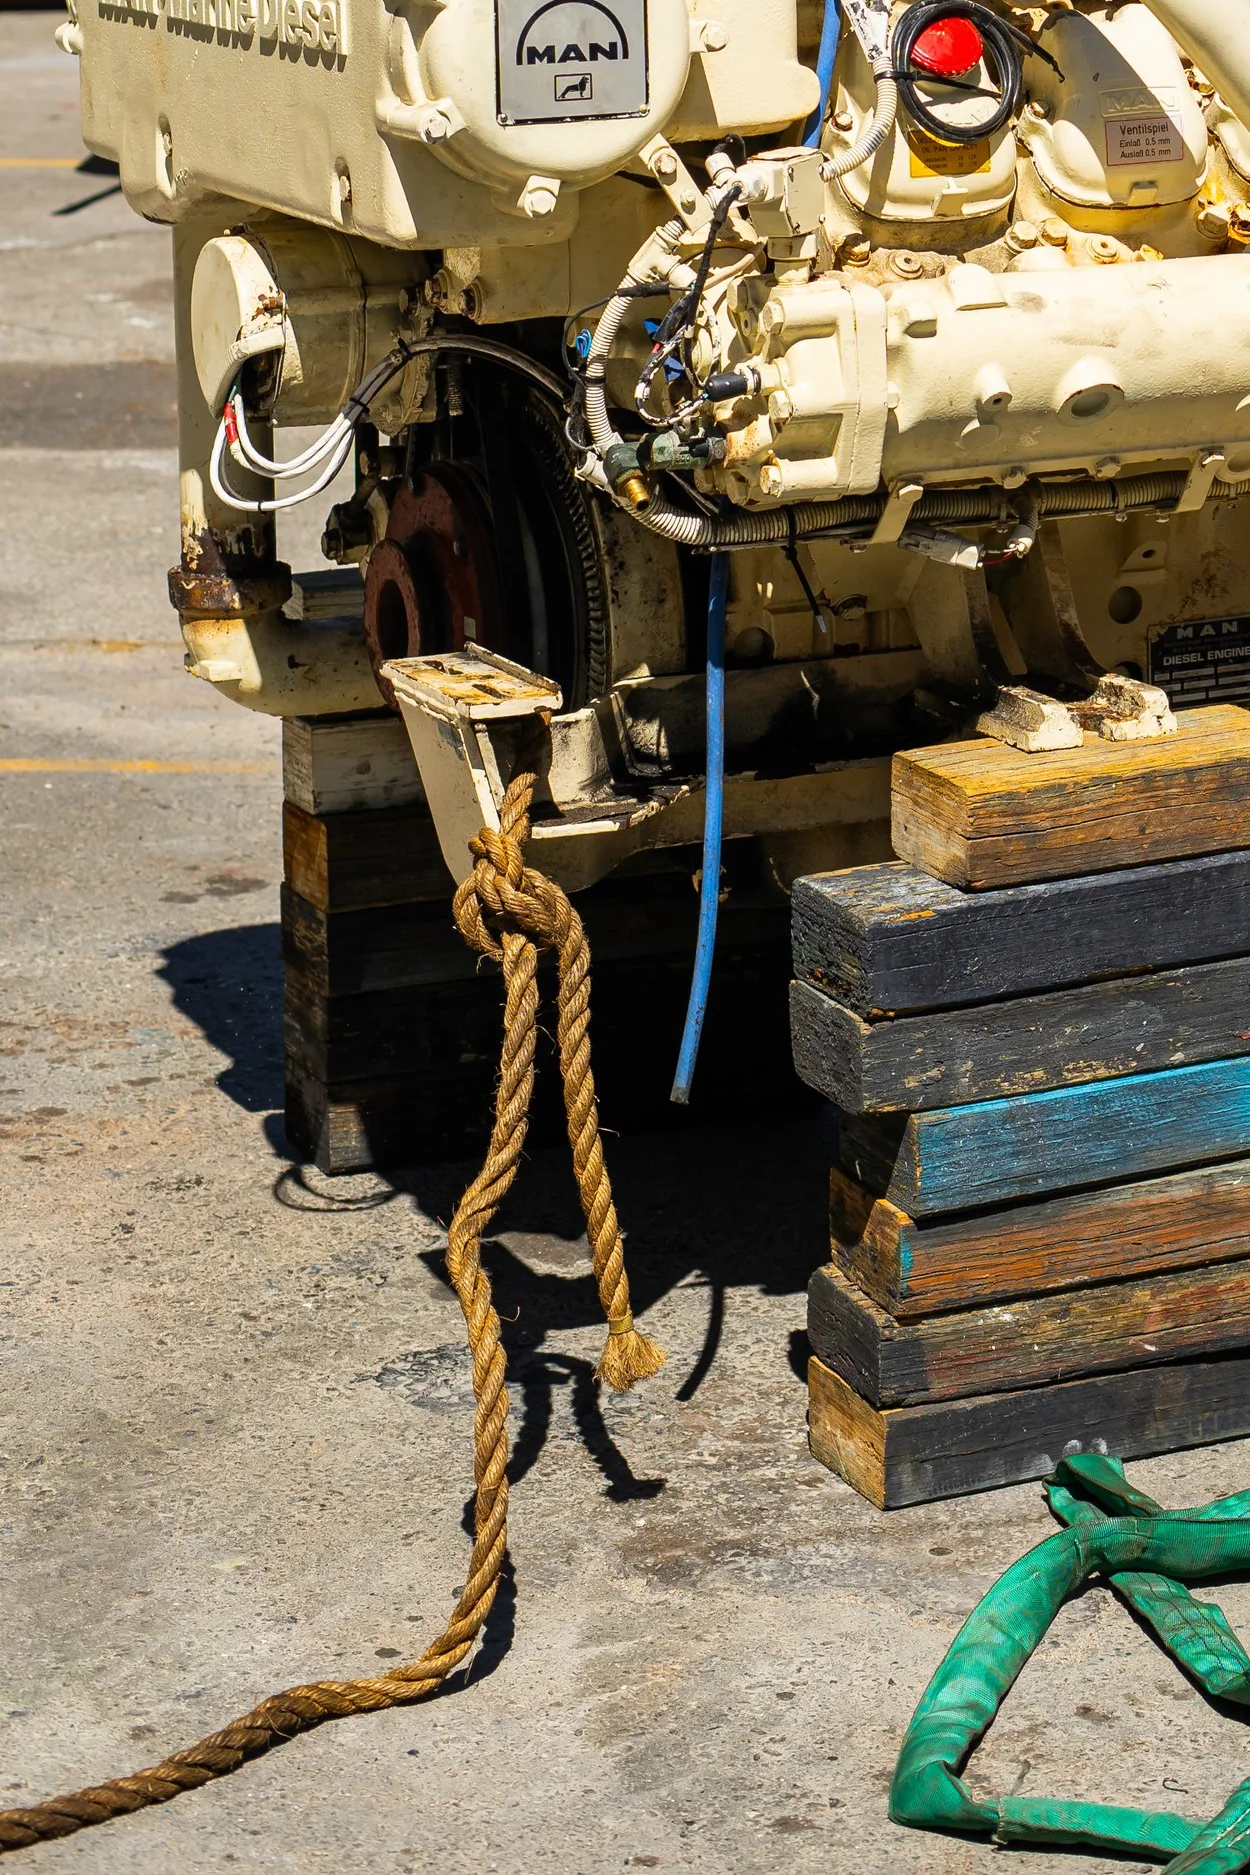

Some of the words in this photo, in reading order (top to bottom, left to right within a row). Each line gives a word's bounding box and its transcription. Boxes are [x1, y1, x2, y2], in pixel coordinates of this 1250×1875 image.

[526, 41, 618, 65] MAN
[1106, 89, 1175, 112] MAN
[1119, 122, 1169, 136] Ventilspiel
[1119, 138, 1141, 148] Einlaß
[1158, 137, 1171, 145] mm
[1120, 149, 1144, 159] Auslaß
[1158, 148, 1171, 156] mm
[1177, 620, 1238, 639] MAN
[1163, 653, 1205, 666] DIESEL
